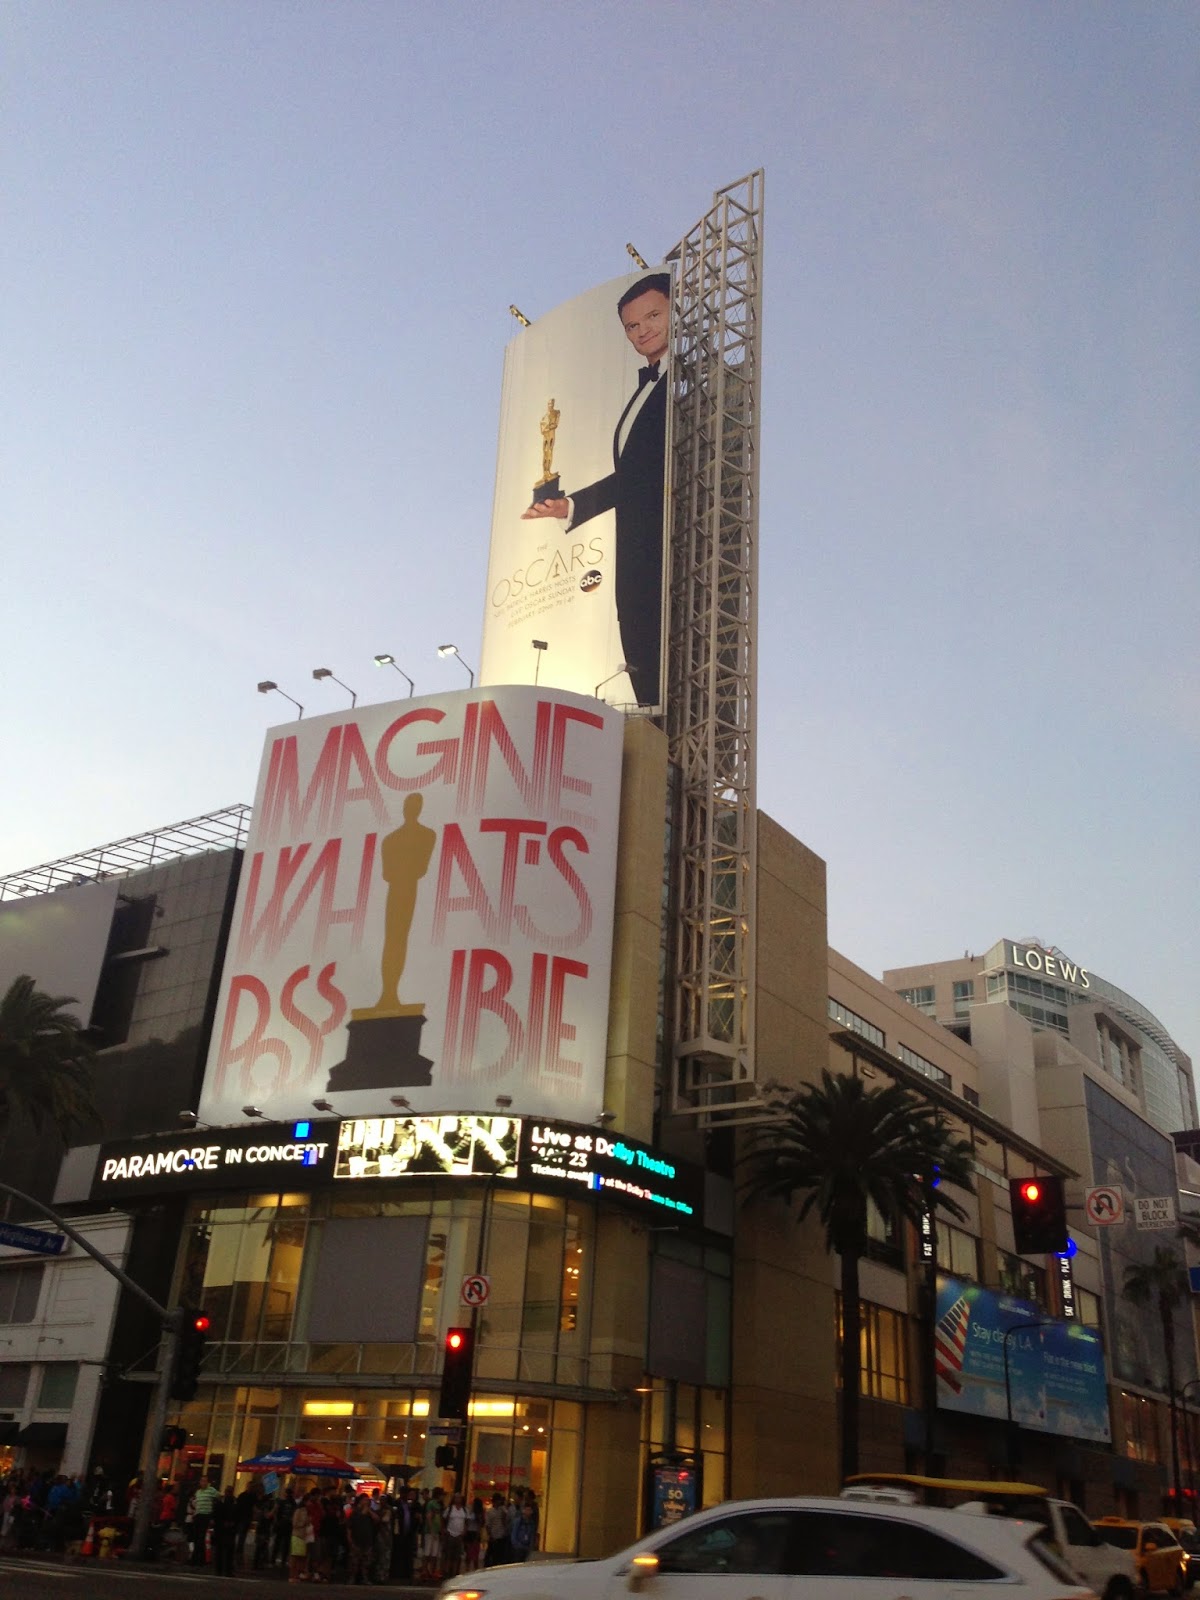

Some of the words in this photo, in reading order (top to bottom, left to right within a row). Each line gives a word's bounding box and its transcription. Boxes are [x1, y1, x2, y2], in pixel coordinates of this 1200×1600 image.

[491, 537, 604, 608] OSCARS
[580, 574, 603, 588] abc
[548, 585, 576, 600] SUNDAY
[259, 700, 605, 842] IMAGINE
[1013, 945, 1090, 989] LOEWS
[212, 948, 589, 1101] POSSIBLE
[531, 1126, 571, 1147] Live
[574, 1135, 592, 1151] at
[596, 1138, 634, 1165] Dolby
[636, 1150, 676, 1178] Theatre
[569, 1151, 588, 1167] 23
[102, 1146, 221, 1181] PARAMORE
[225, 1148, 243, 1164] IN
[531, 1163, 566, 1178] Tickets
[1138, 1200, 1149, 1210] DO
[1153, 1199, 1169, 1209] NOT
[1142, 1210, 1168, 1221] BLOCK
[1060, 1257, 1070, 1273] PLAY
[1062, 1279, 1072, 1299] DRINK
[1064, 1305, 1074, 1317] EAT
[972, 1321, 991, 1345] Stay
